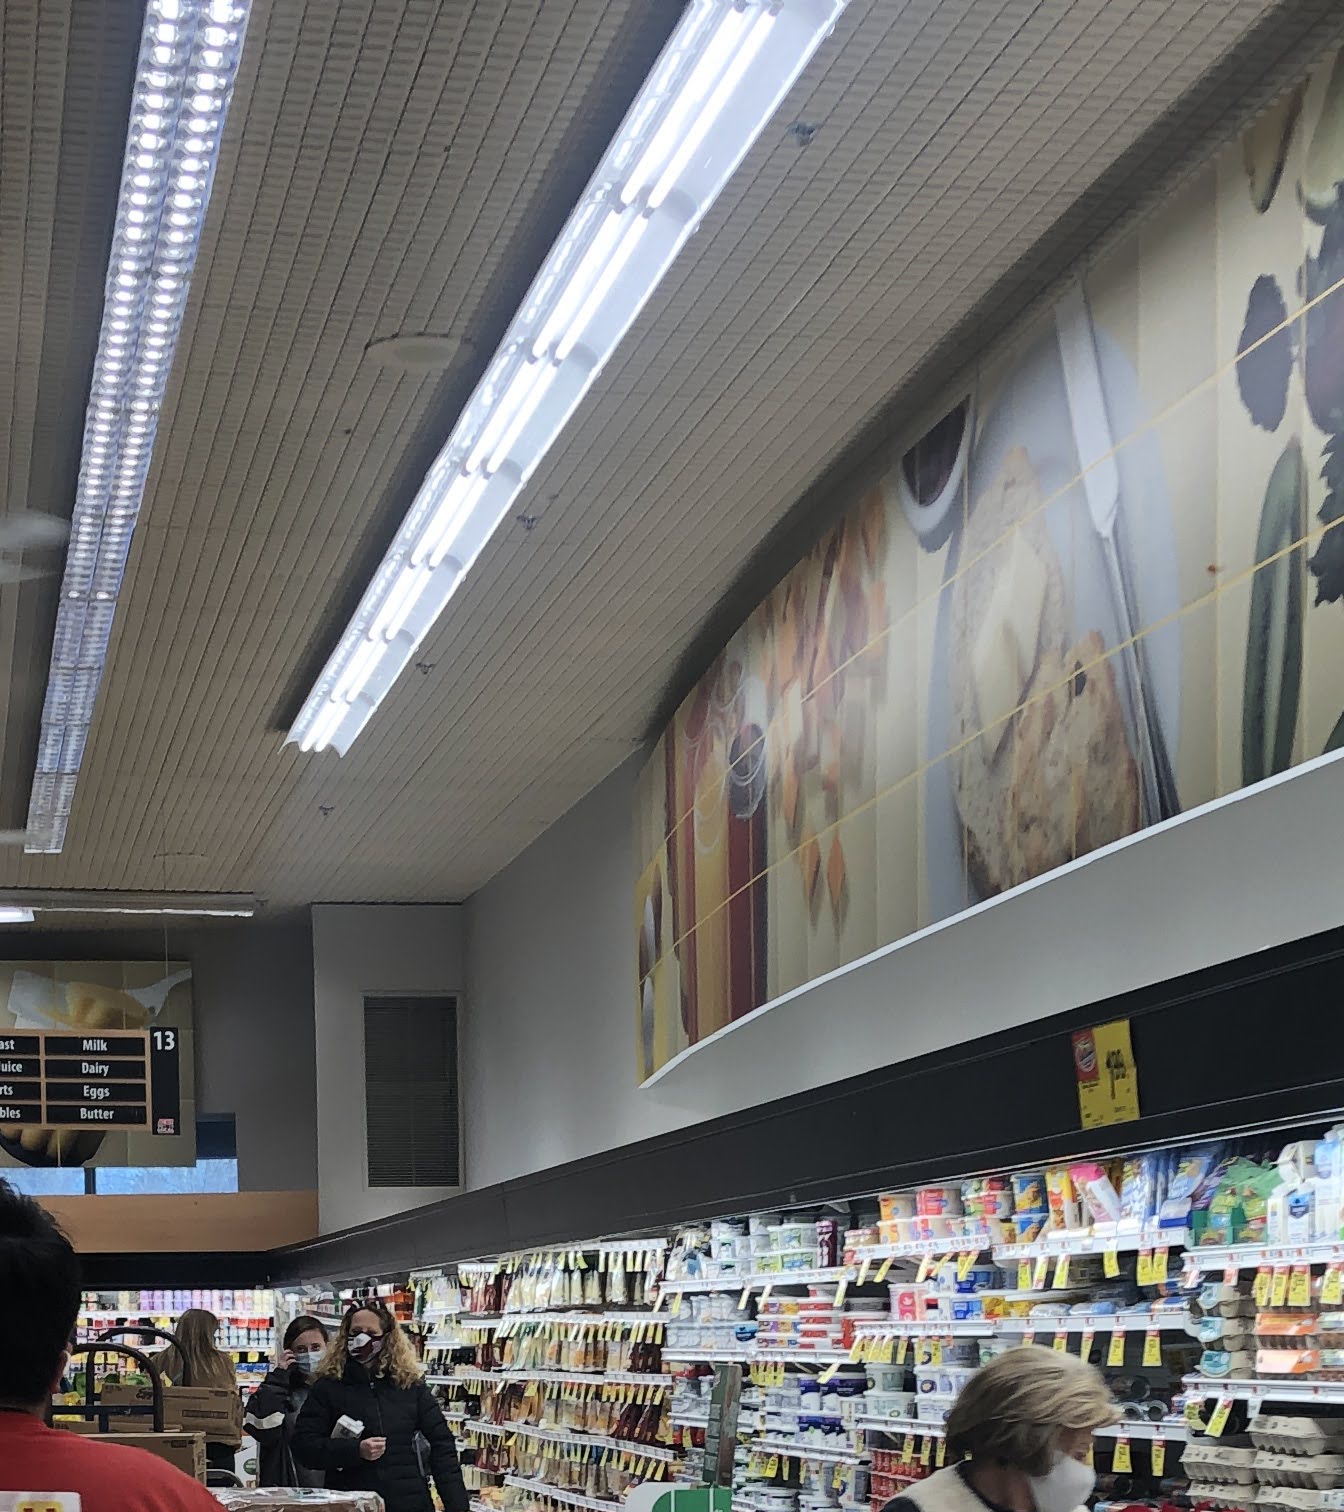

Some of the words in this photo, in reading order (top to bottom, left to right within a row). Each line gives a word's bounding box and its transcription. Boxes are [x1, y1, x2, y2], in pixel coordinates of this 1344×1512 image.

[82, 1039, 108, 1052] Milk
[153, 1030, 175, 1051] 13
[81, 1062, 109, 1077] Dairy
[83, 1085, 110, 1098] Eggs
[80, 1107, 115, 1121] Butter
